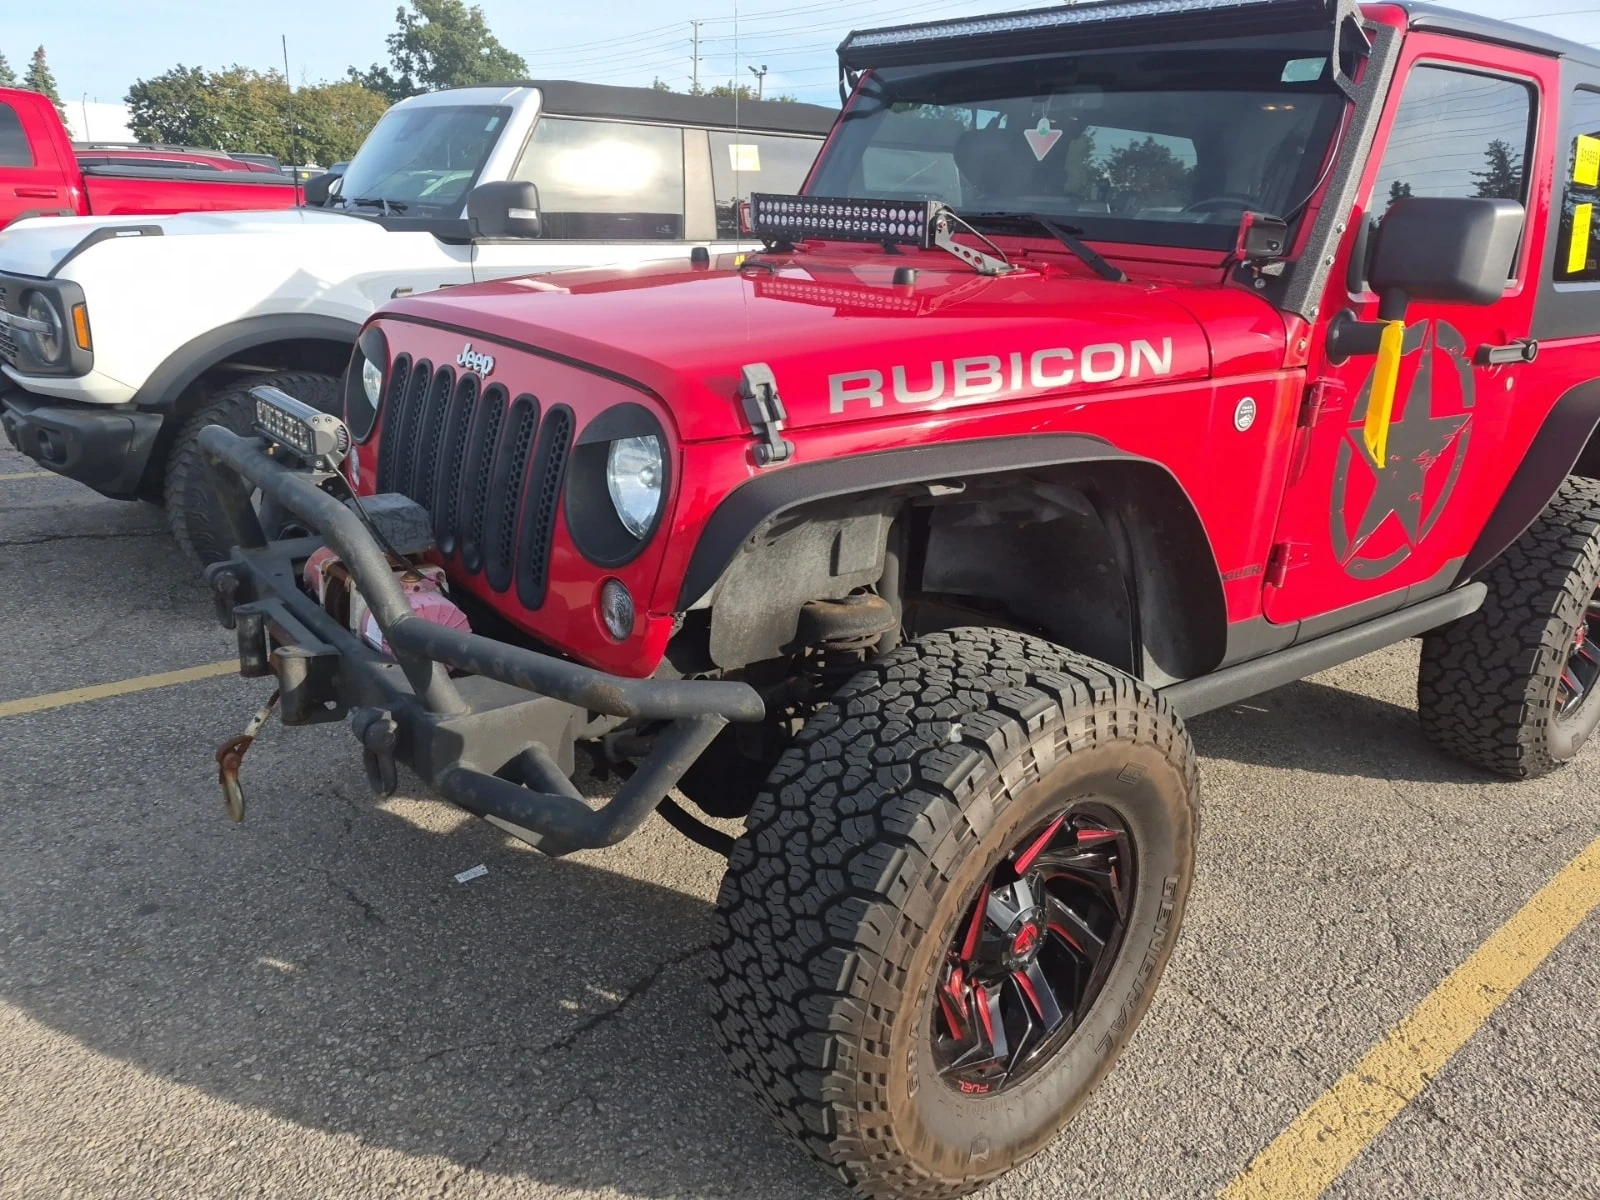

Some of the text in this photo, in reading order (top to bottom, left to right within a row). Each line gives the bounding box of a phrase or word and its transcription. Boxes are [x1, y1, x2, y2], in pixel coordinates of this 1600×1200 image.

[456, 343, 495, 380] Jeep
[829, 337, 1172, 414] RUBICON
[1222, 564, 1261, 581] GLER
[1095, 874, 1180, 1055] GENERAL
[958, 1080, 989, 1093] FUEL
